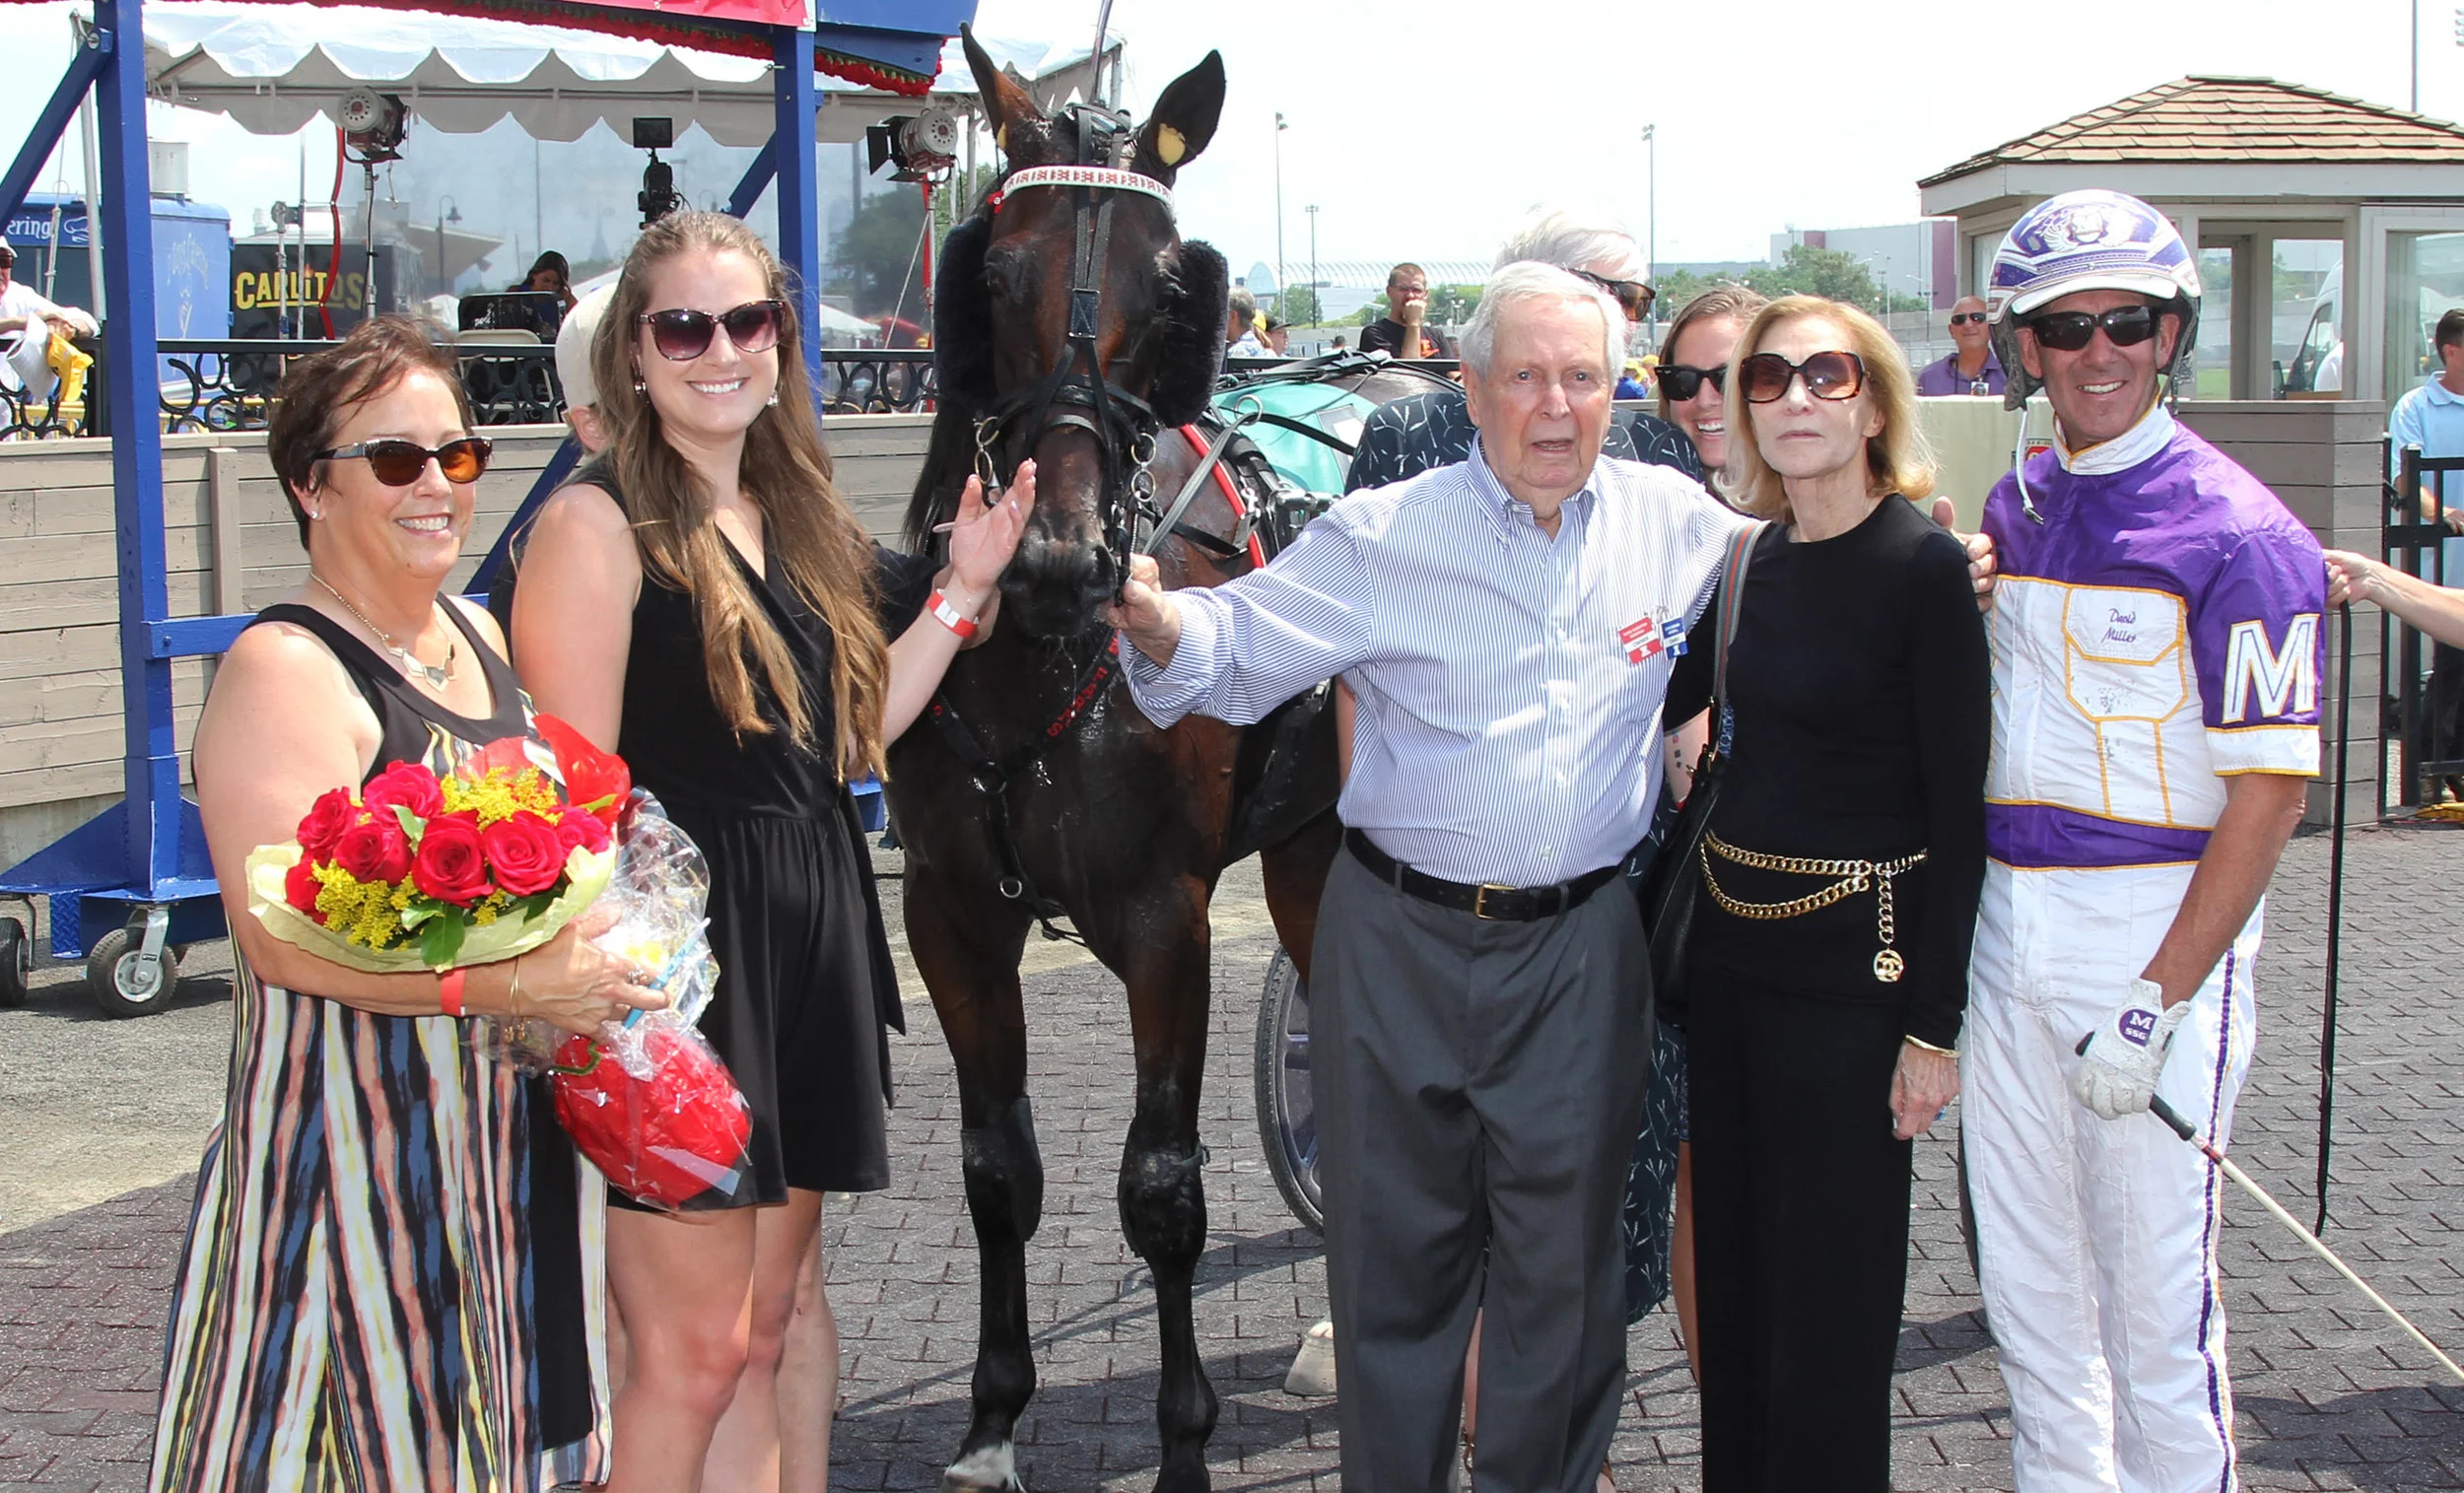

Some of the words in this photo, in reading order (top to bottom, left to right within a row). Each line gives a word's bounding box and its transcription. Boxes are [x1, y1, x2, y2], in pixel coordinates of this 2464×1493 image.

[6, 216, 52, 239] ering
[2222, 613, 2321, 724] M
[2129, 1011, 2154, 1031] M
